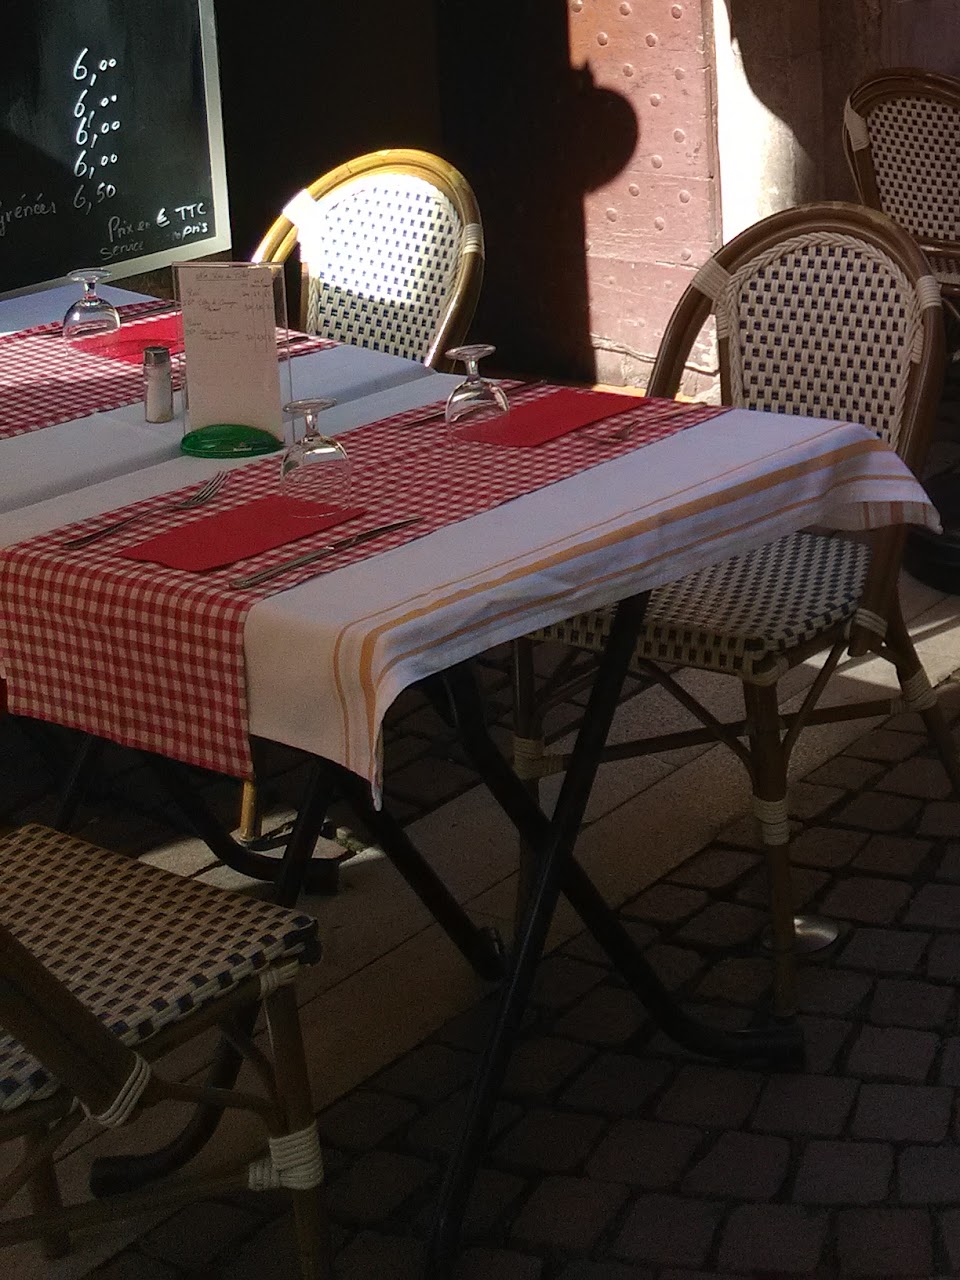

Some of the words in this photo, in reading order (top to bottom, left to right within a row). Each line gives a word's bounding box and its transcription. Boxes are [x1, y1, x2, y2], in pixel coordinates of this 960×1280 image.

[73, 48, 117, 86] 6,00
[74, 89, 117, 128] 6,00
[76, 117, 120, 148] 6,00
[74, 150, 117, 179] 6,00
[0, 193, 56, 236] yrénées
[73, 184, 116, 215] 6,50
[108, 216, 133, 242] Prix
[156, 208, 170, 227] €
[175, 203, 206, 220] TTC
